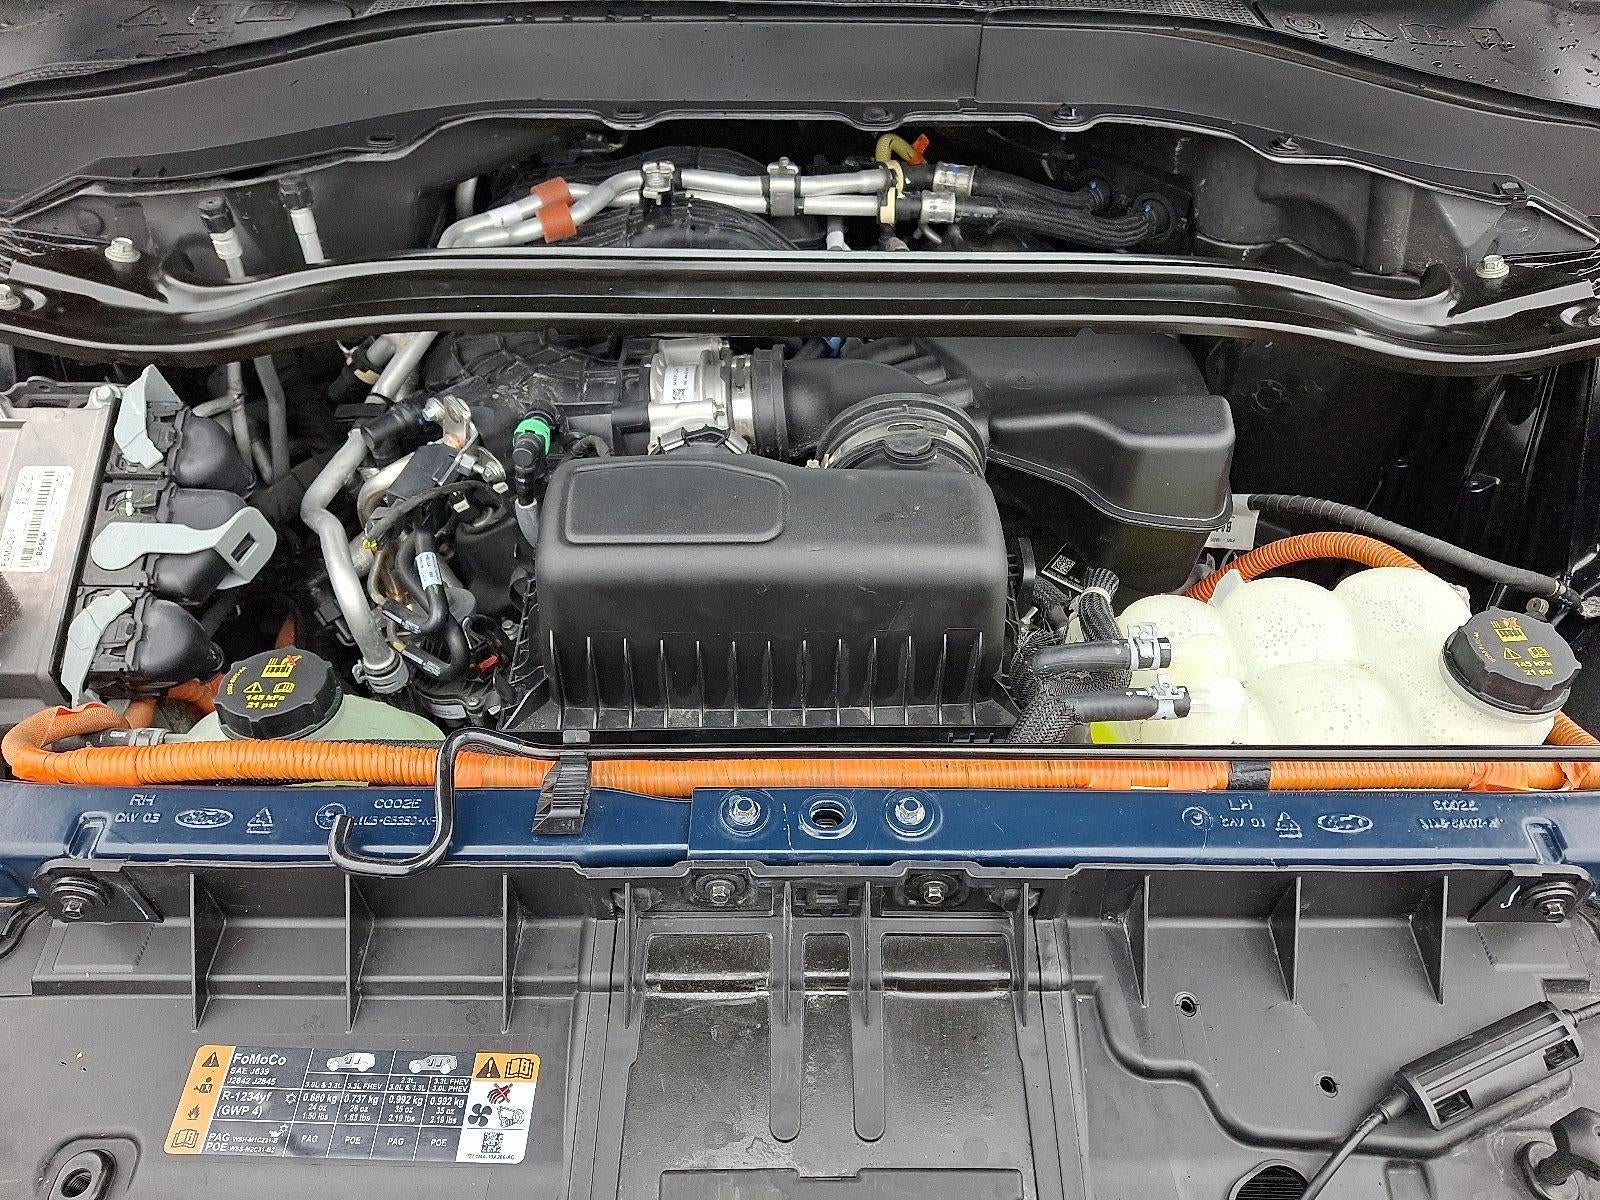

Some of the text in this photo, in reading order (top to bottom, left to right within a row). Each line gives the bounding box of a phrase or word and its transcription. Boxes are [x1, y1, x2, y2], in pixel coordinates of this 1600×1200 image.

[1538, 668, 1554, 677] psi
[261, 701, 278, 709] psi
[232, 1053, 287, 1066] FoMoCo
[229, 1067, 270, 1075] SAE J639
[346, 1082, 362, 1090] 3.3L
[449, 1078, 470, 1086] FHEV
[447, 1085, 469, 1093] PHEV
[221, 1091, 272, 1104] R-1234yf
[326, 1094, 338, 1105] kg
[343, 1094, 379, 1106] 0.737 kg
[388, 1095, 424, 1107] 0.992 kg
[429, 1096, 465, 1108] 0.992 kg
[216, 1105, 263, 1118] (GWP 4)
[307, 1103, 318, 1111] 24
[394, 1105, 404, 1113] 35
[435, 1107, 445, 1115] 35
[302, 1112, 329, 1121] 1.50 lbs
[359, 1114, 371, 1122] lbs
[404, 1115, 416, 1123] lbs
[445, 1116, 457, 1124] lbs
[207, 1133, 231, 1142] PAG
[300, 1134, 319, 1143] PAG
[344, 1136, 362, 1145] POE
[386, 1137, 405, 1146] PAG
[204, 1142, 228, 1152] POE
[430, 1138, 448, 1147] POE
